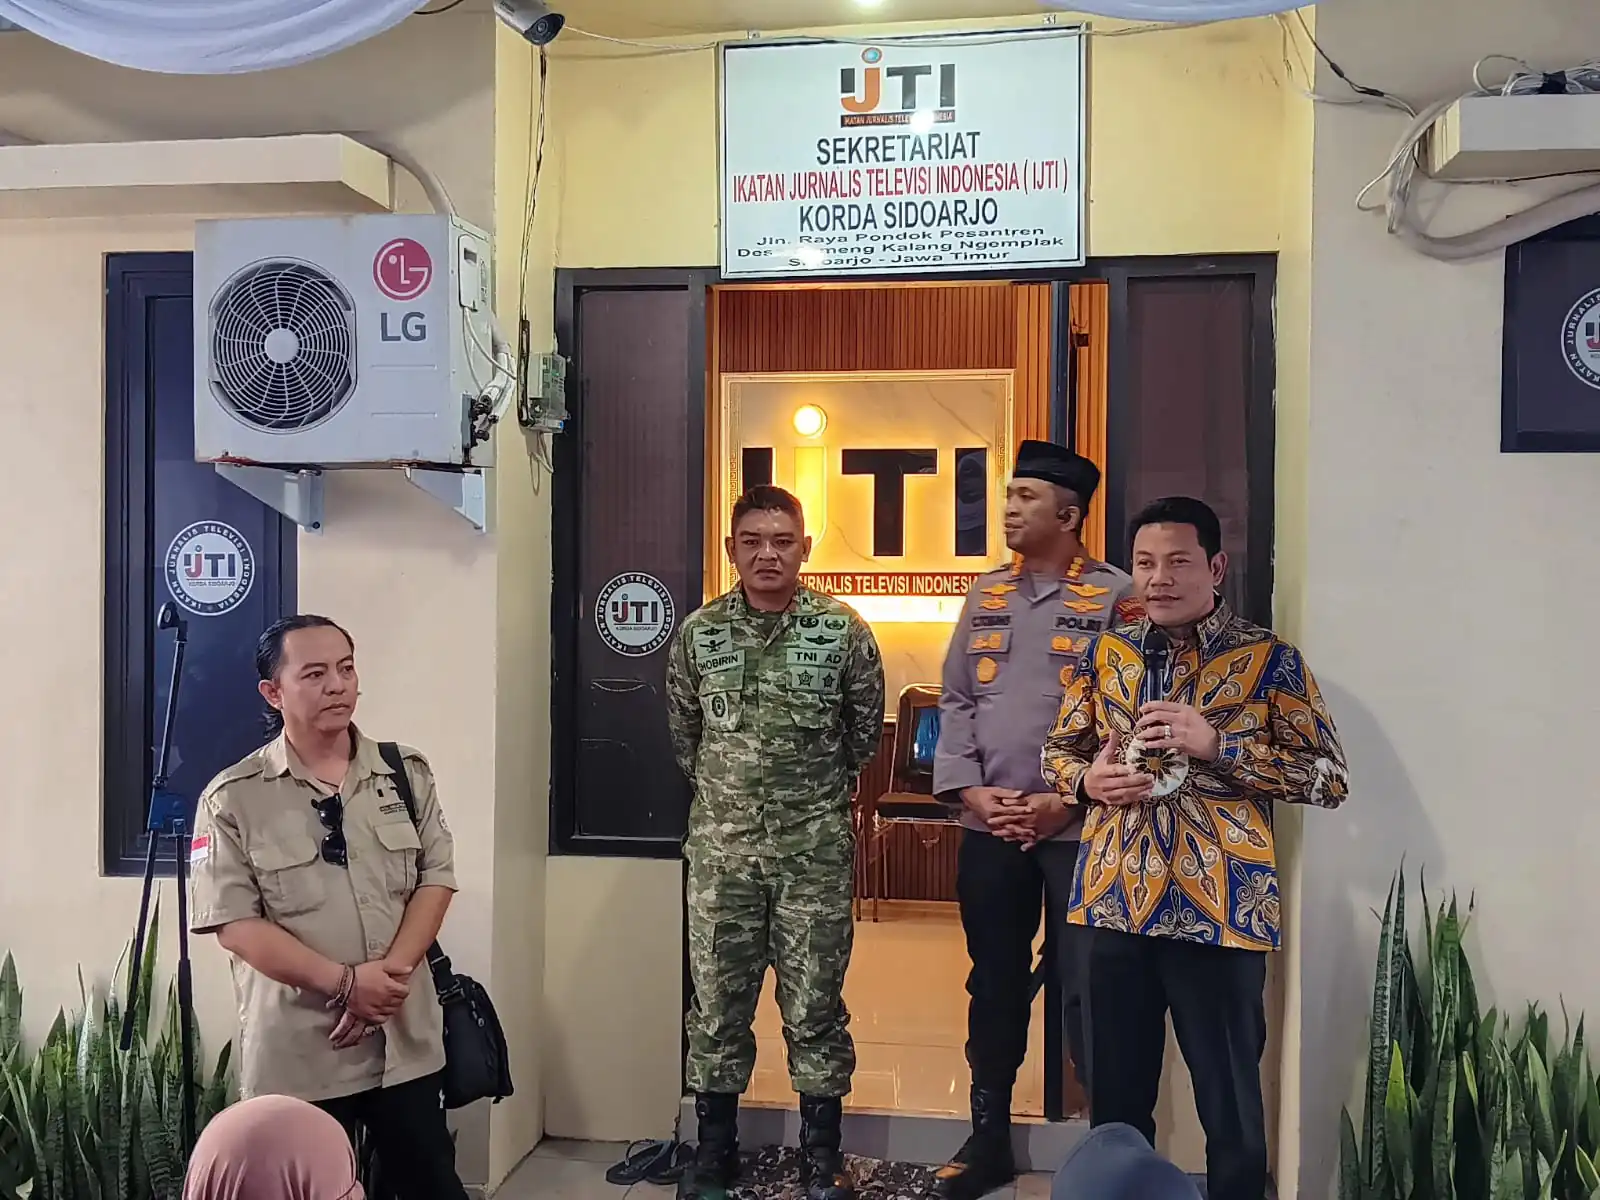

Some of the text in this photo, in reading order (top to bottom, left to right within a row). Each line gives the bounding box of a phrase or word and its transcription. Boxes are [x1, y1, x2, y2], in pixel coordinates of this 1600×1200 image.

[817, 131, 981, 165] SEKRETARIAT
[733, 173, 785, 202] IKATAN
[789, 169, 862, 200] JURNALIS
[866, 166, 932, 196] TELEVISI
[936, 162, 1020, 194] INDONESIA
[800, 198, 998, 232] KORDA SIDOARJO
[756, 228, 1044, 246] Jln. Raya Pondok Pesantren
[882, 242, 952, 252] Kalang
[960, 237, 1064, 250] Ngemplak
[891, 254, 943, 264] Jawa
[951, 251, 1010, 261] Timur
[380, 311, 427, 342] LG
[168, 526, 250, 609] IKATAN JURNALIS TELEVISI INDONESIA
[855, 575, 911, 594] TELEVISI
[598, 576, 671, 652] IKATAN JURNALIS TELEVISI INDONESIA
[795, 652, 842, 664] TNI AD
